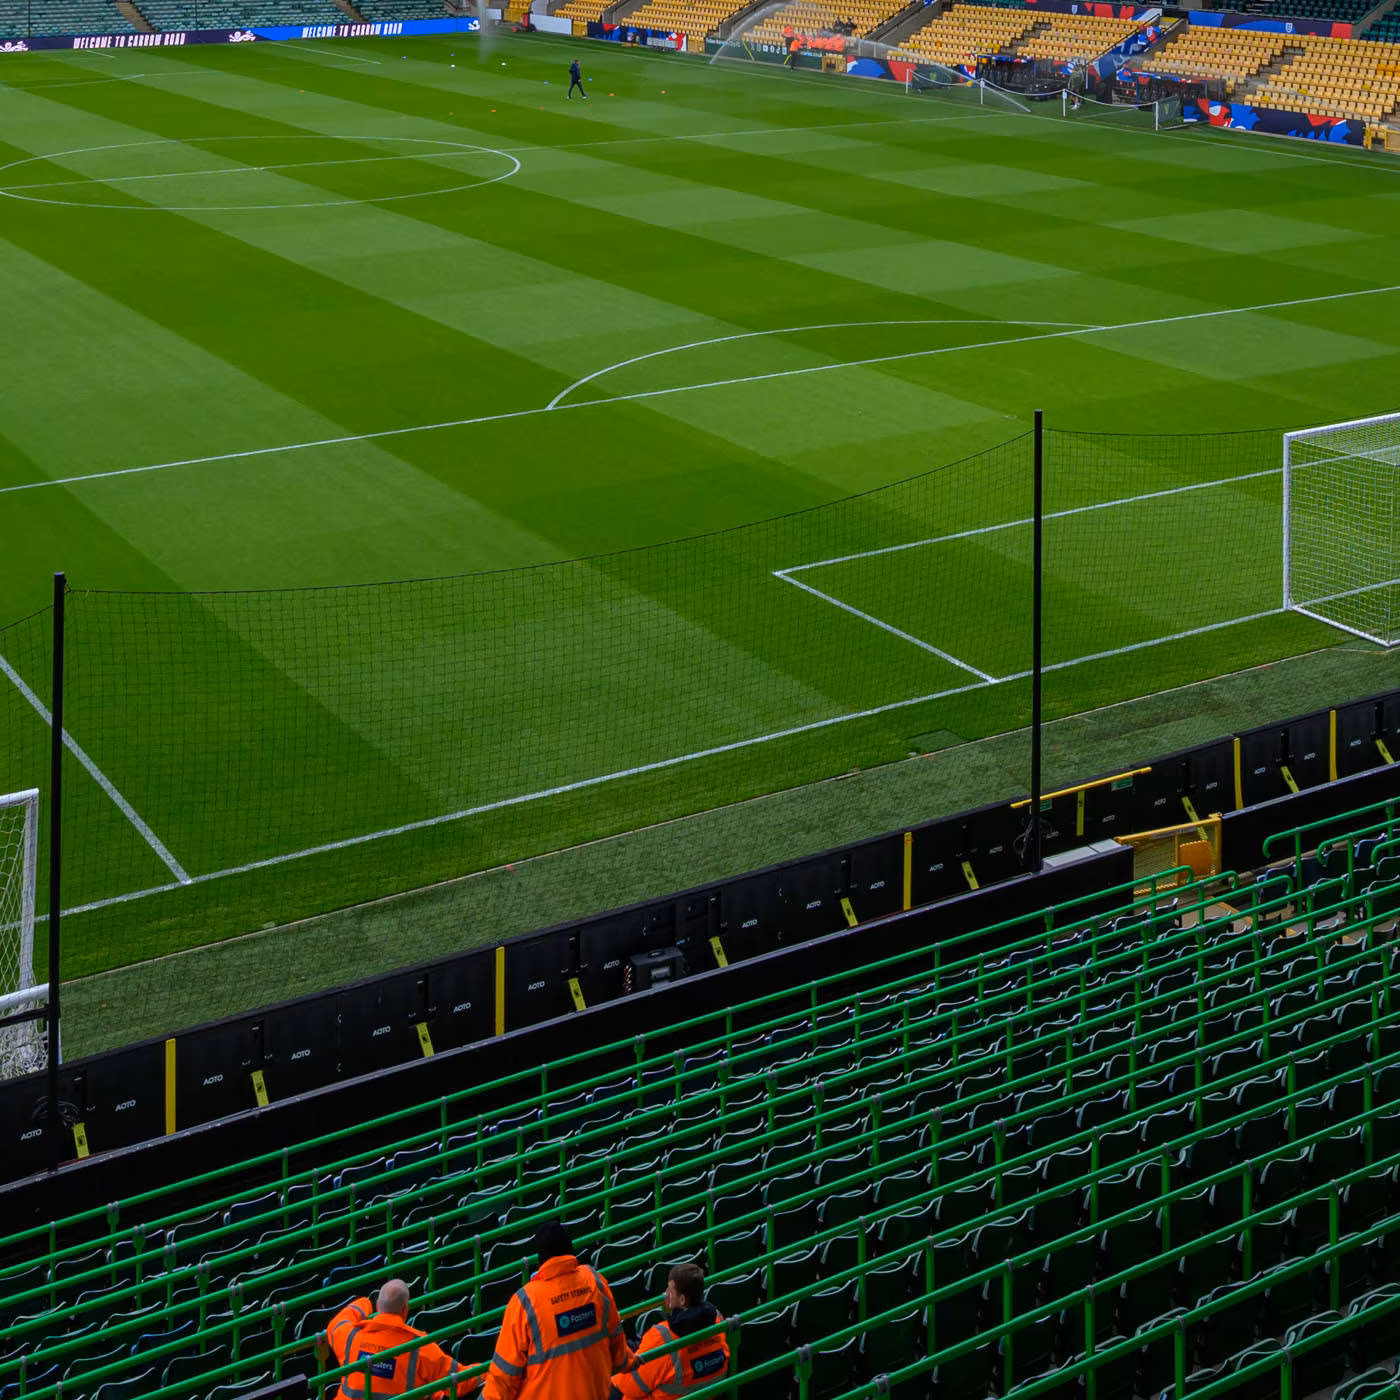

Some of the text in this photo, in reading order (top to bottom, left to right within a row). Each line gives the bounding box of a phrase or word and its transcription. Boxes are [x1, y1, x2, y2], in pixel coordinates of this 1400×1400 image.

[302, 22, 402, 38] WELCOME TO CARROW ROAD
[73, 33, 186, 49] WELCOME TO CARROW ROAD
[806, 900, 821, 909] AOTO
[742, 919, 757, 928] AOTO
[604, 960, 619, 970] AOTO
[528, 981, 545, 991] AOTO
[454, 1003, 471, 1012] AOTO
[373, 1026, 391, 1036] AOTO
[291, 1049, 310, 1060] AOTO
[203, 1075, 223, 1085] AOTO
[115, 1100, 136, 1111] AOTO
[21, 1129, 42, 1140] AOTO
[570, 1310, 594, 1323] Fosters
